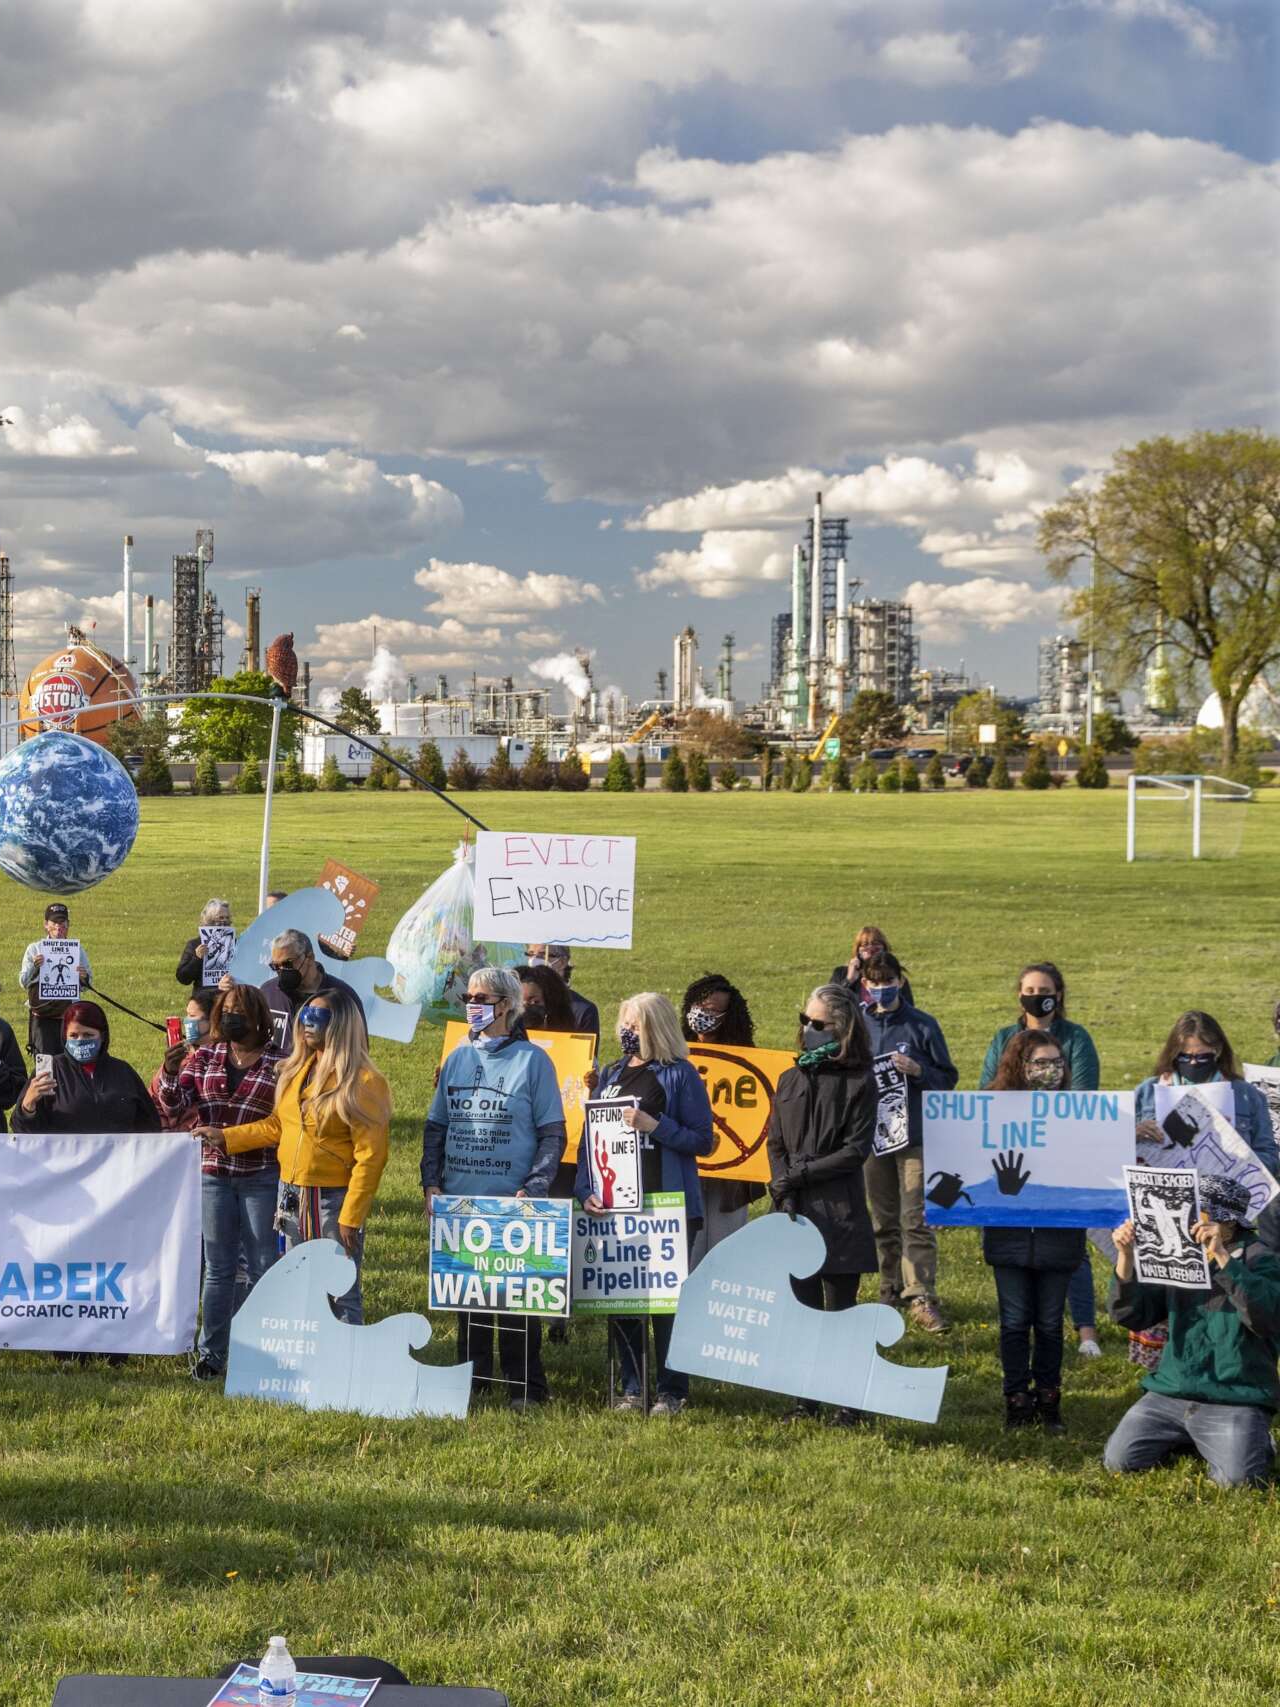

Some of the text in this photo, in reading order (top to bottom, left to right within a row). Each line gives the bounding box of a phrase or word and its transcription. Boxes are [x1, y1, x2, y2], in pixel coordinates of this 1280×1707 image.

[44, 683, 76, 692] DETROIT
[30, 692, 90, 712] PISTONS
[505, 837, 621, 867] EVICT
[488, 877, 630, 916] ENBRIDGE
[888, 1070, 898, 1084] 5
[698, 1066, 758, 1108] ine
[450, 1098, 508, 1111] NO OIL
[925, 1092, 1118, 1121] SHUT DOWN
[590, 1108, 622, 1123] DEFUND
[982, 1120, 1046, 1149] LINE
[456, 1142, 464, 1150] for
[471, 1144, 495, 1152] years!
[611, 1141, 628, 1155] LINE
[630, 1141, 634, 1154] 5
[576, 1216, 680, 1236] Shut Down
[434, 1217, 566, 1257] NO OIL
[603, 1238, 675, 1262] Line 5
[474, 1257, 526, 1273] IN OUR
[1141, 1264, 1204, 1282] WATER DEFENDER
[582, 1267, 678, 1295] Pipeline
[433, 1273, 566, 1310] WATERS
[711, 1280, 777, 1303] FOR THE
[79, 1306, 129, 1319] PARTY
[708, 1300, 770, 1326] WATER
[262, 1318, 319, 1332] FOR THE
[723, 1324, 748, 1340] WE
[260, 1338, 315, 1355] WATER
[701, 1343, 760, 1367] DRINK
[277, 1358, 297, 1370] WE
[258, 1378, 312, 1394] DRINK
